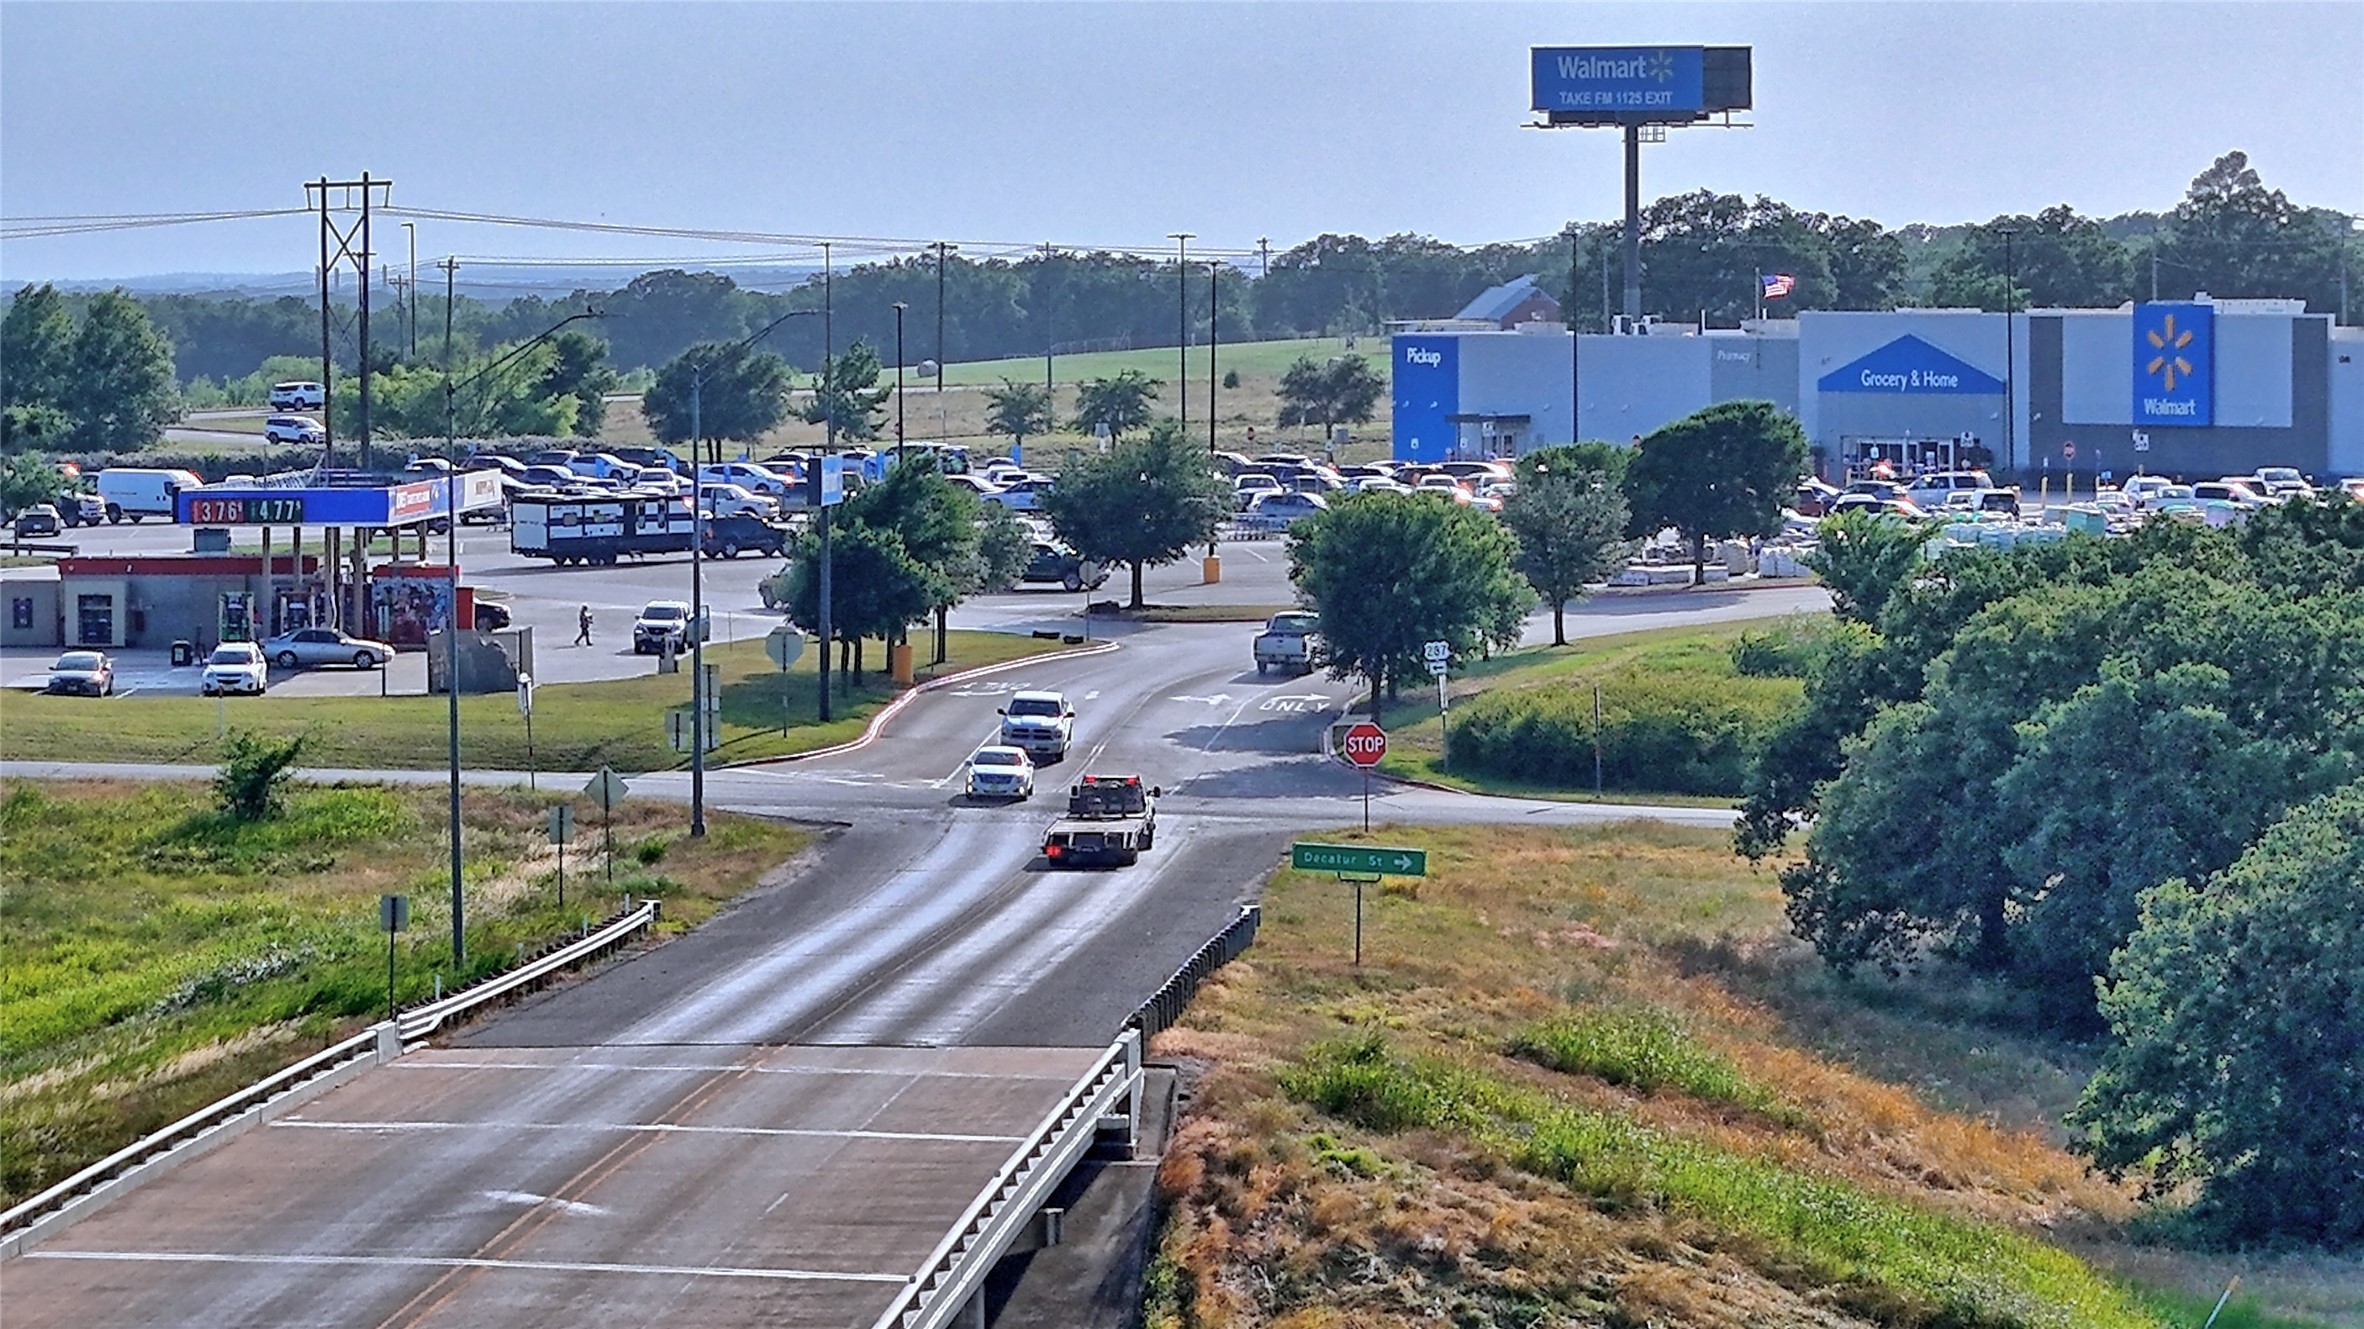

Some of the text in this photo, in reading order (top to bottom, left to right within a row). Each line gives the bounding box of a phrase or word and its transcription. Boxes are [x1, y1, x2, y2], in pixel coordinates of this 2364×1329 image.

[1557, 55, 1647, 79] Walmart
[1559, 91, 1674, 105] TAKE FM 1125 EXIT
[1407, 347, 1442, 368] Pickup
[1861, 367, 1958, 391] Grocery & Home
[2143, 398, 2196, 416] Walmart
[1426, 645, 1448, 656] 287
[1259, 699, 1331, 713] ONLY
[1347, 736, 1384, 753] STOP
[1303, 850, 1383, 867] Decatur St
